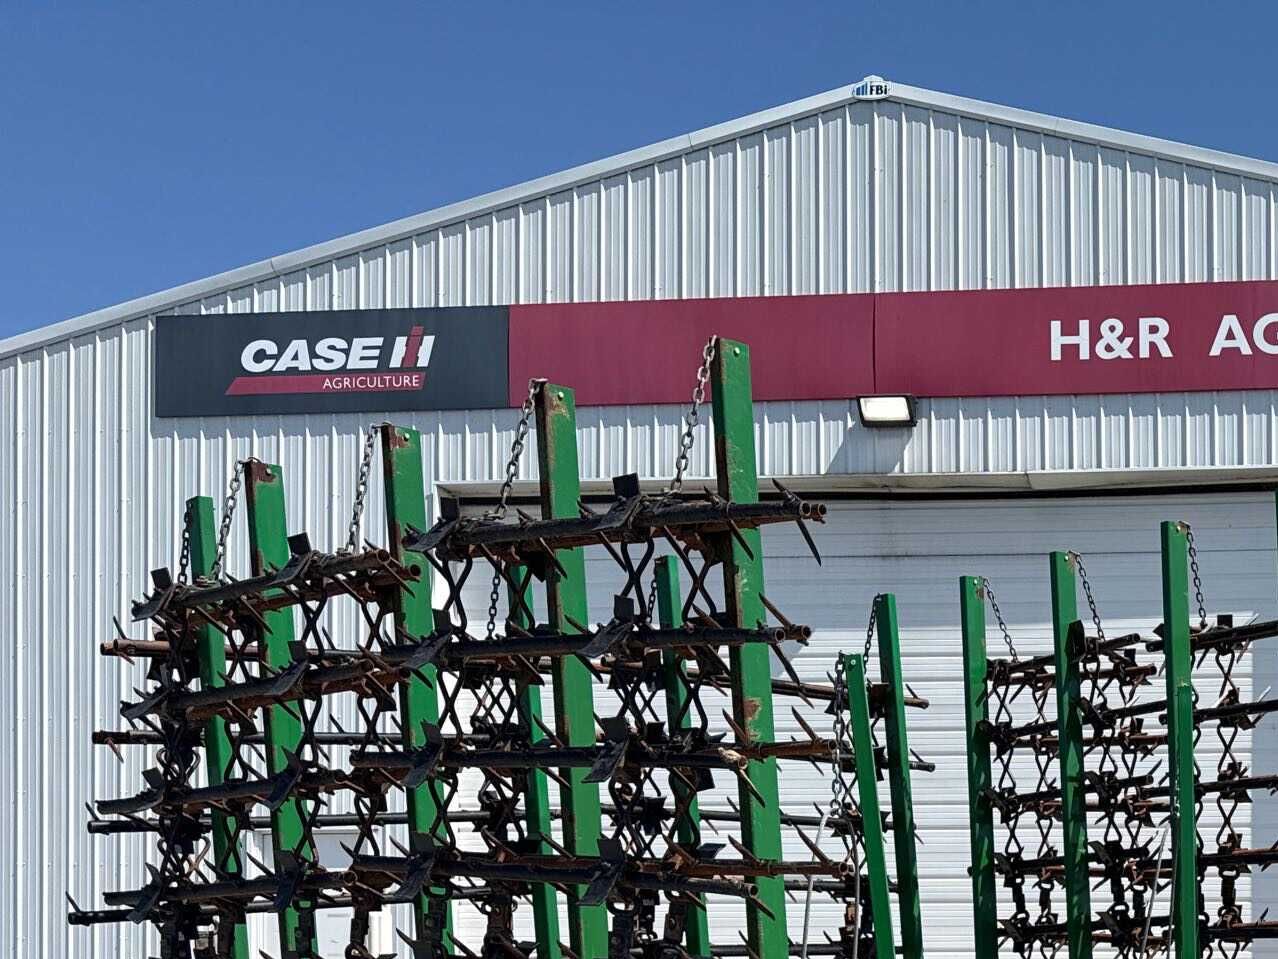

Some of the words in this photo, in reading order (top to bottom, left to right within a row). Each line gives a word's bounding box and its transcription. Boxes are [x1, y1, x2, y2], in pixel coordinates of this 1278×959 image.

[240, 336, 384, 373] CASE
[1049, 316, 1173, 361] H&R
[322, 375, 419, 390] AGRICULTURE
